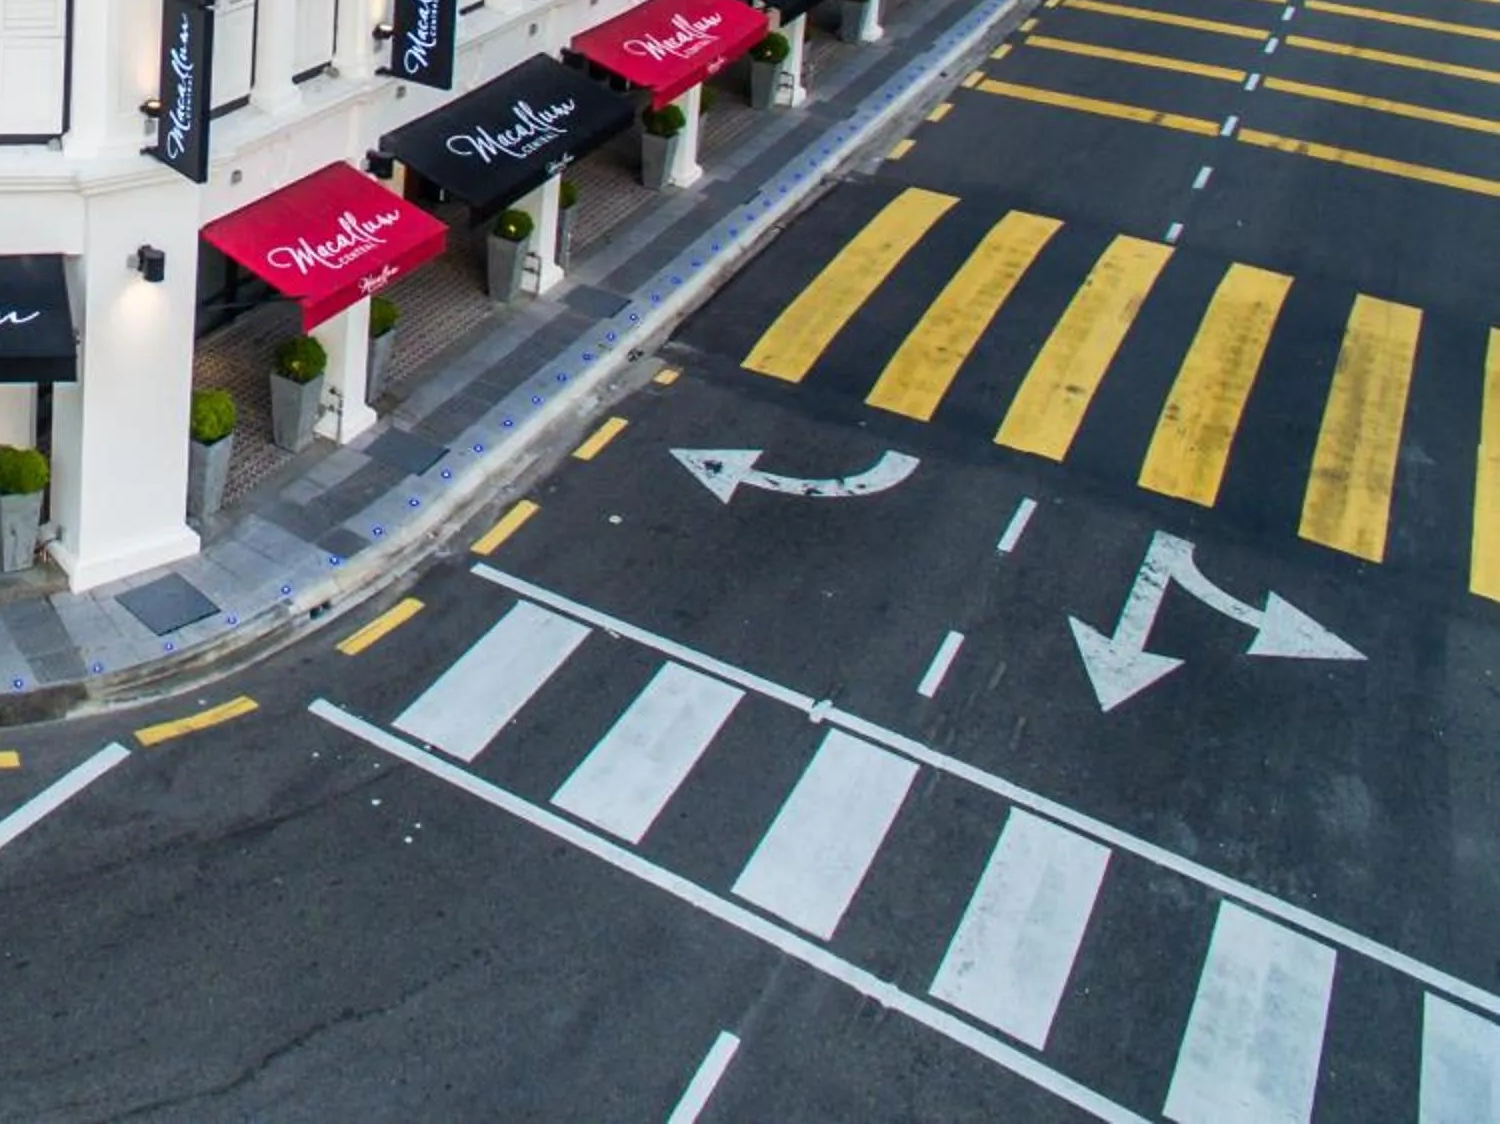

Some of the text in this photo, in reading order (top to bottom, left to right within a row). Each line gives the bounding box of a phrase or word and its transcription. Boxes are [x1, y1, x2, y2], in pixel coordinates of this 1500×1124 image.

[167, 12, 193, 159] Macallum
[445, 98, 575, 164] Macallum
[267, 209, 400, 275] Macallum
